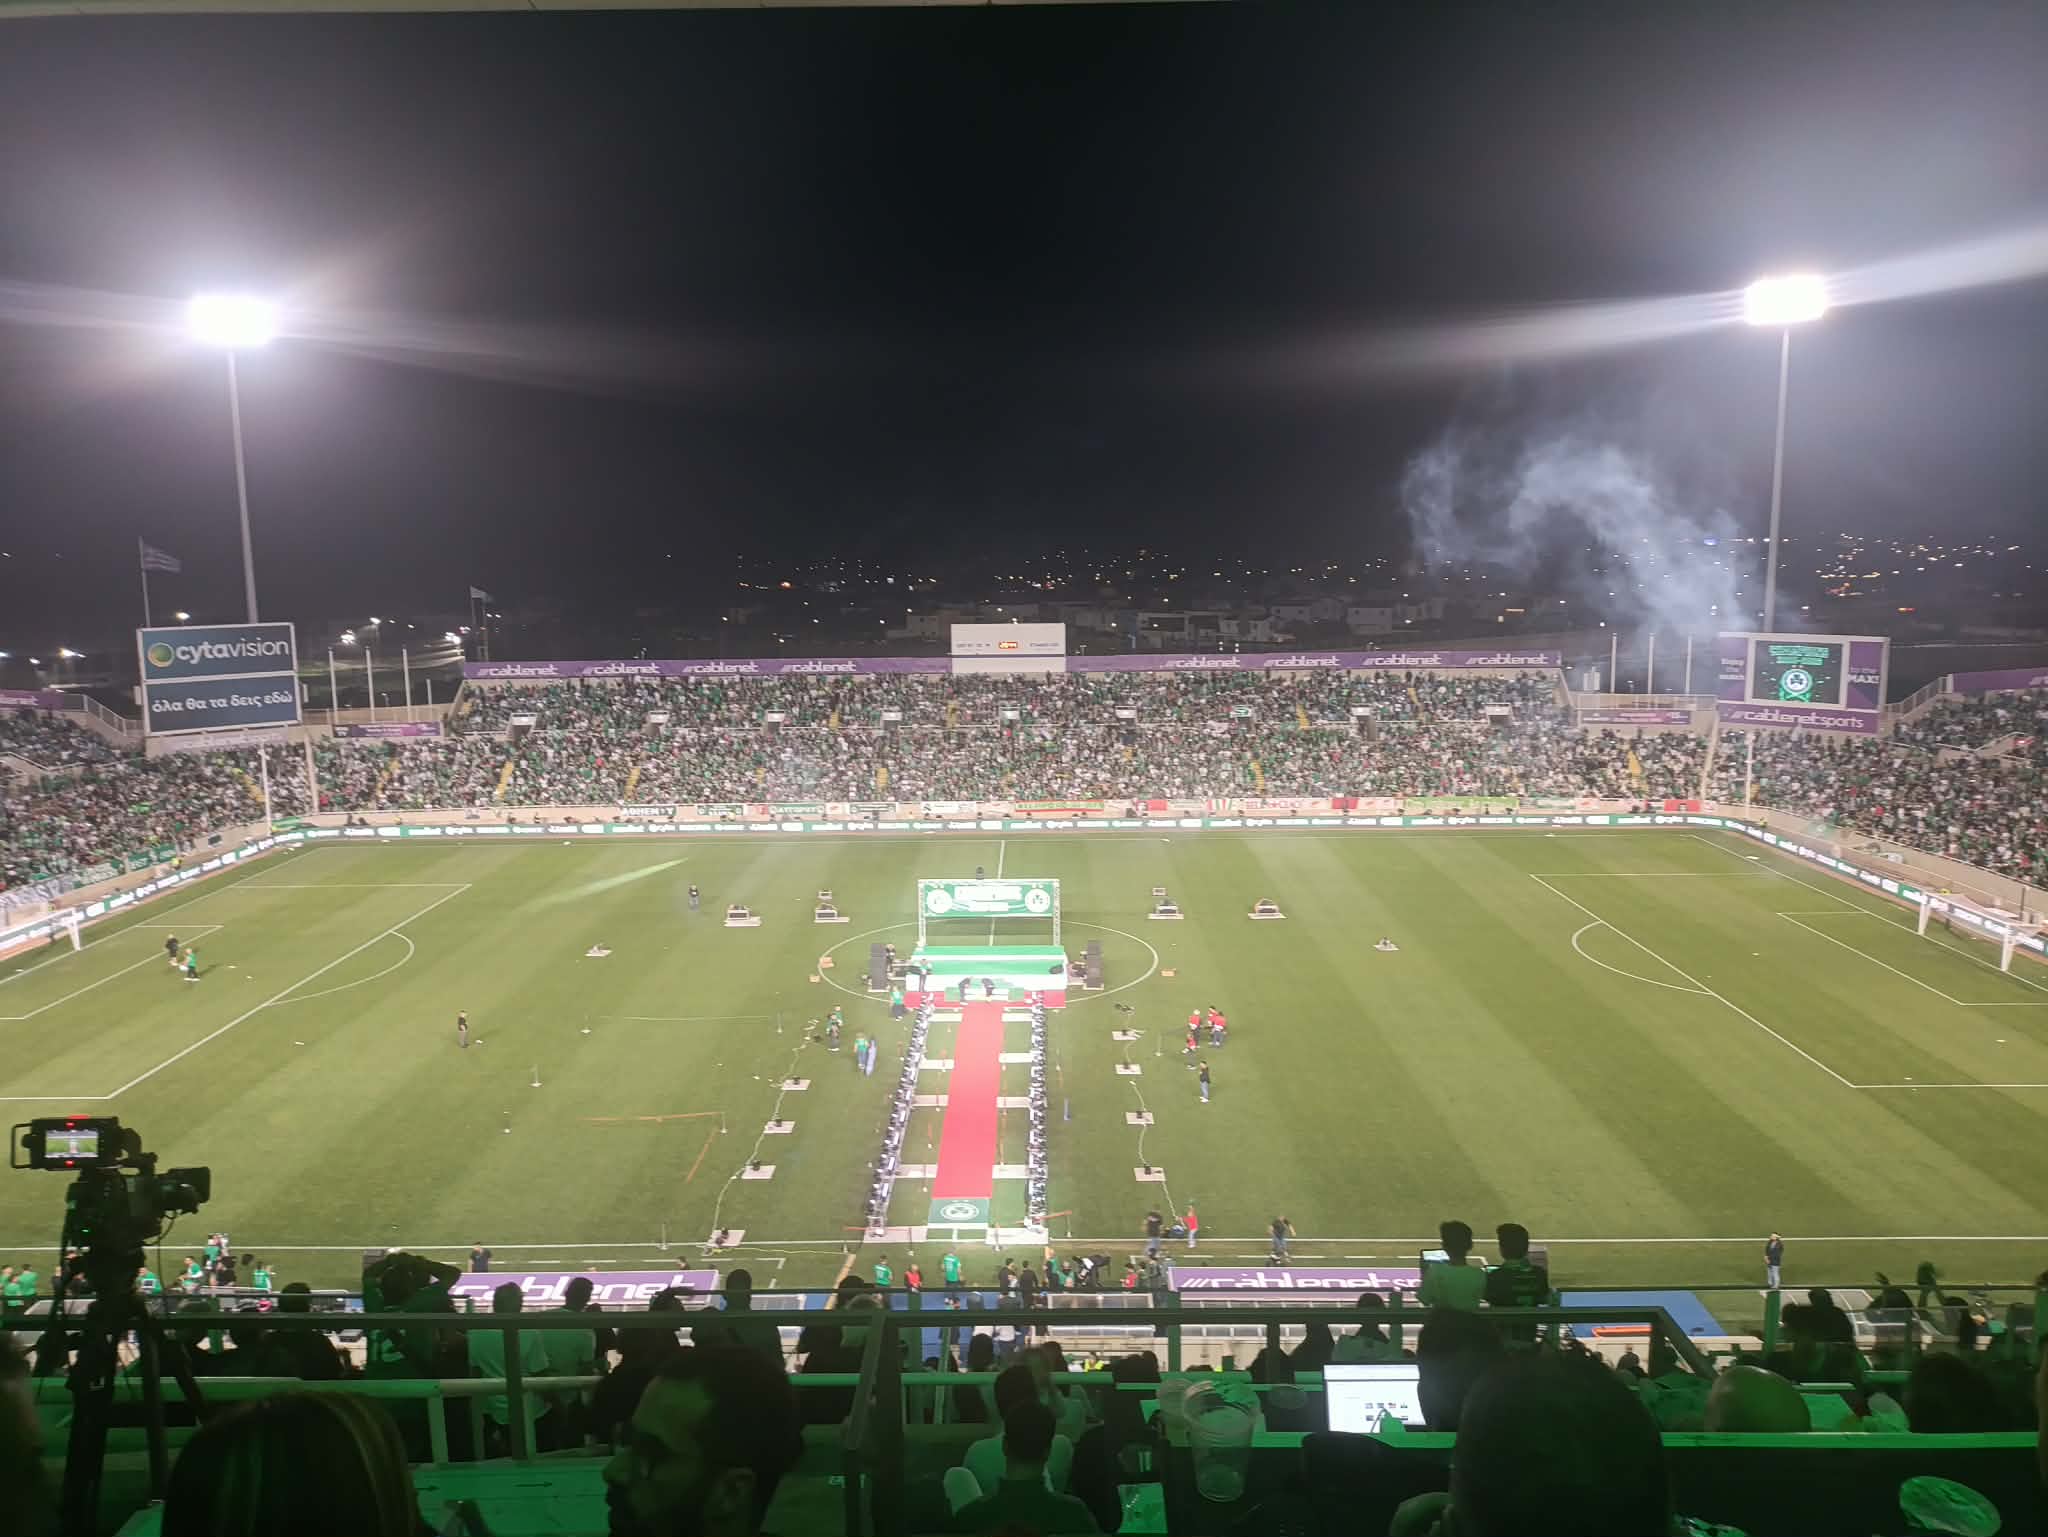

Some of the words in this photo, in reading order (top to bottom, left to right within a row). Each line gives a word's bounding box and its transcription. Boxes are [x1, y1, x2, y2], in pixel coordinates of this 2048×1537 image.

[176, 638, 289, 665] cytavision
[693, 658, 759, 673] cablenet
[1175, 656, 1240, 668] cablenet
[1274, 655, 1341, 667] cablenet
[1375, 653, 1442, 665] cablenet
[1479, 653, 1548, 665] cablenet
[489, 664, 559, 676] cablenet
[593, 661, 660, 675] cablenet
[792, 659, 856, 673] cablenet
[152, 700, 184, 713] όλα
[186, 698, 207, 710] θα
[209, 699, 229, 709] τα
[230, 694, 263, 708] δεις
[264, 692, 293, 704] εδώ
